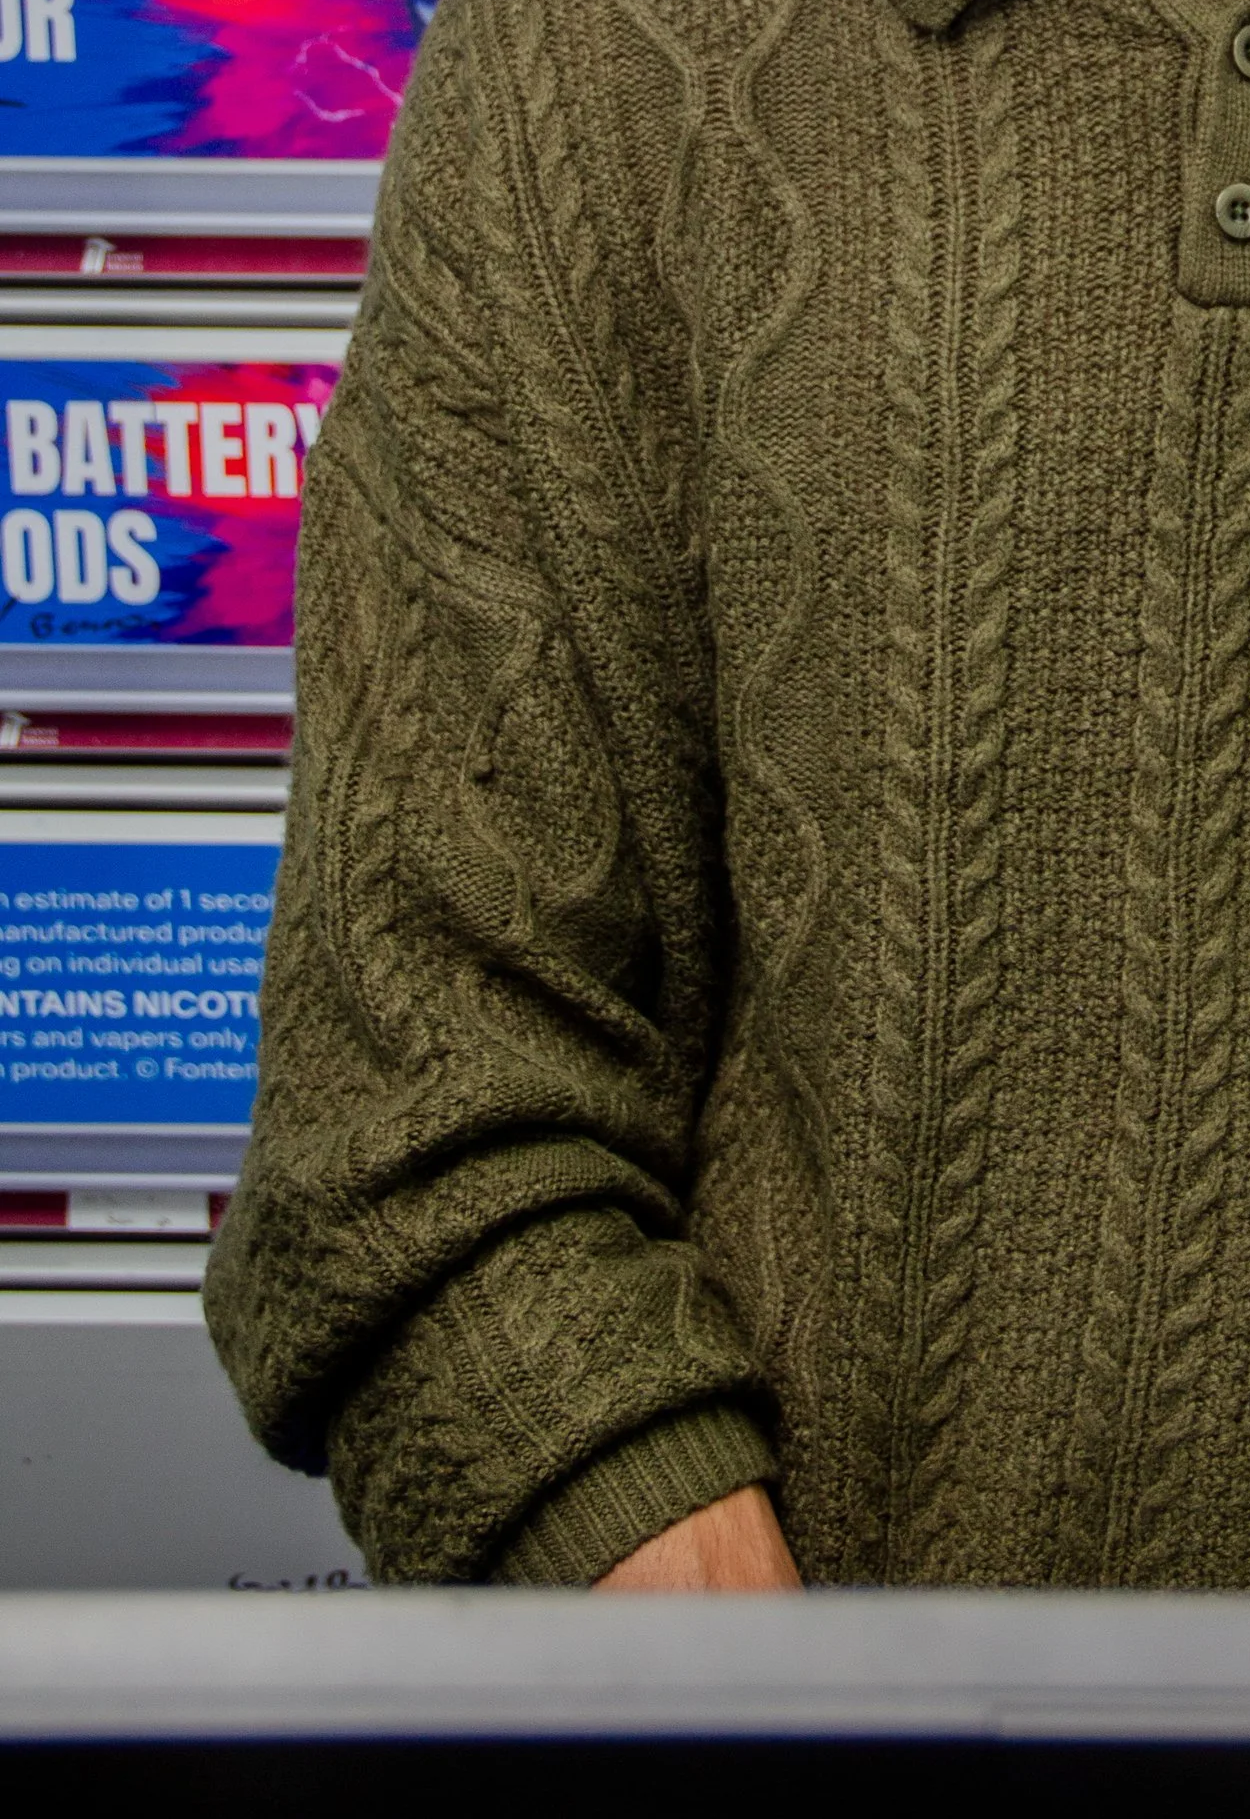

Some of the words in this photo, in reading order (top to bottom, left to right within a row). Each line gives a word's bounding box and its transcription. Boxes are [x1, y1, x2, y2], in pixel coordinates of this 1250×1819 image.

[1, 509, 161, 606] ODS
[14, 888, 139, 912] estimate
[145, 888, 172, 912] of
[180, 888, 191, 910] 1
[26, 956, 62, 974] on
[67, 951, 202, 975] individual
[31, 1027, 83, 1049] and
[91, 1031, 184, 1053] vapers
